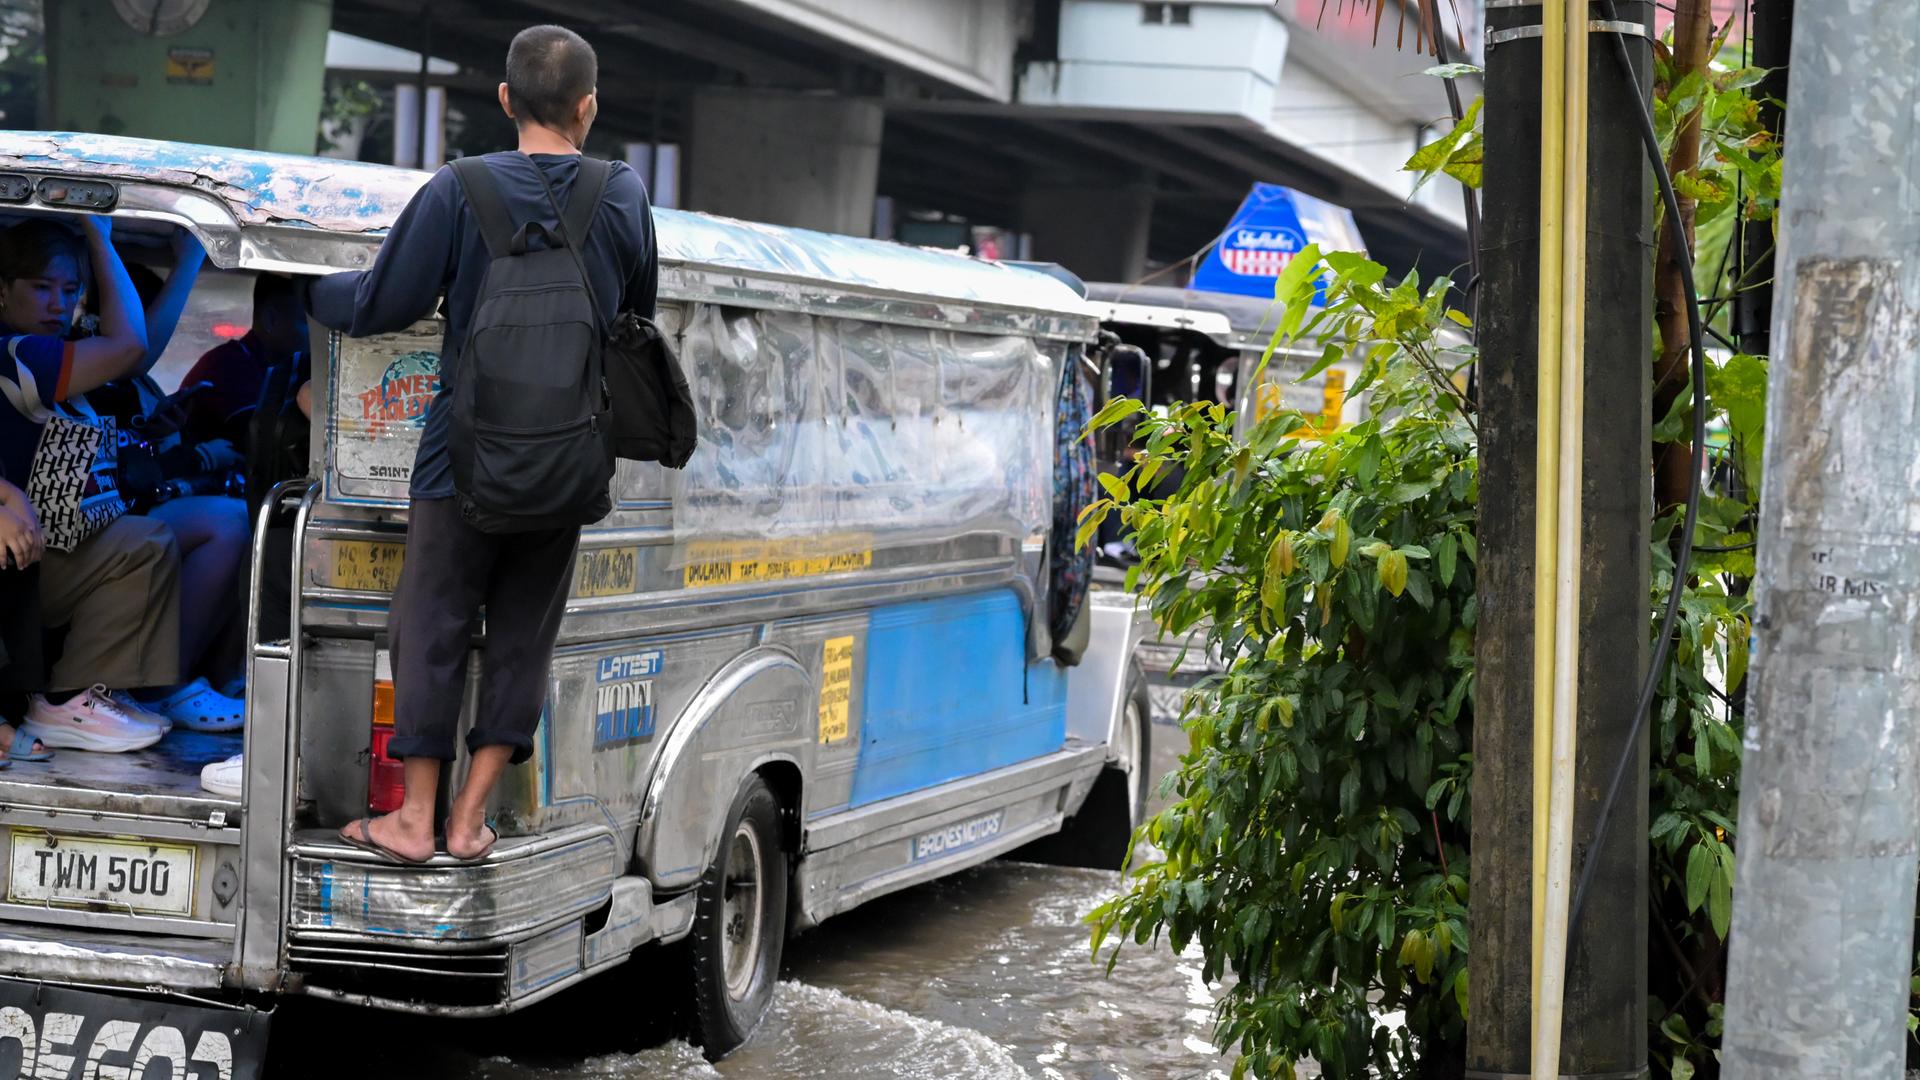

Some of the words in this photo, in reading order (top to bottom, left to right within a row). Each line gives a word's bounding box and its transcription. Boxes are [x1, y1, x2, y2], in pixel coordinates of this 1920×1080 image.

[369, 465, 410, 479] SAINT
[601, 652, 660, 681] LATEST
[594, 680, 657, 745] MODEL
[34, 850, 98, 891] TWM
[107, 856, 170, 896] 500
